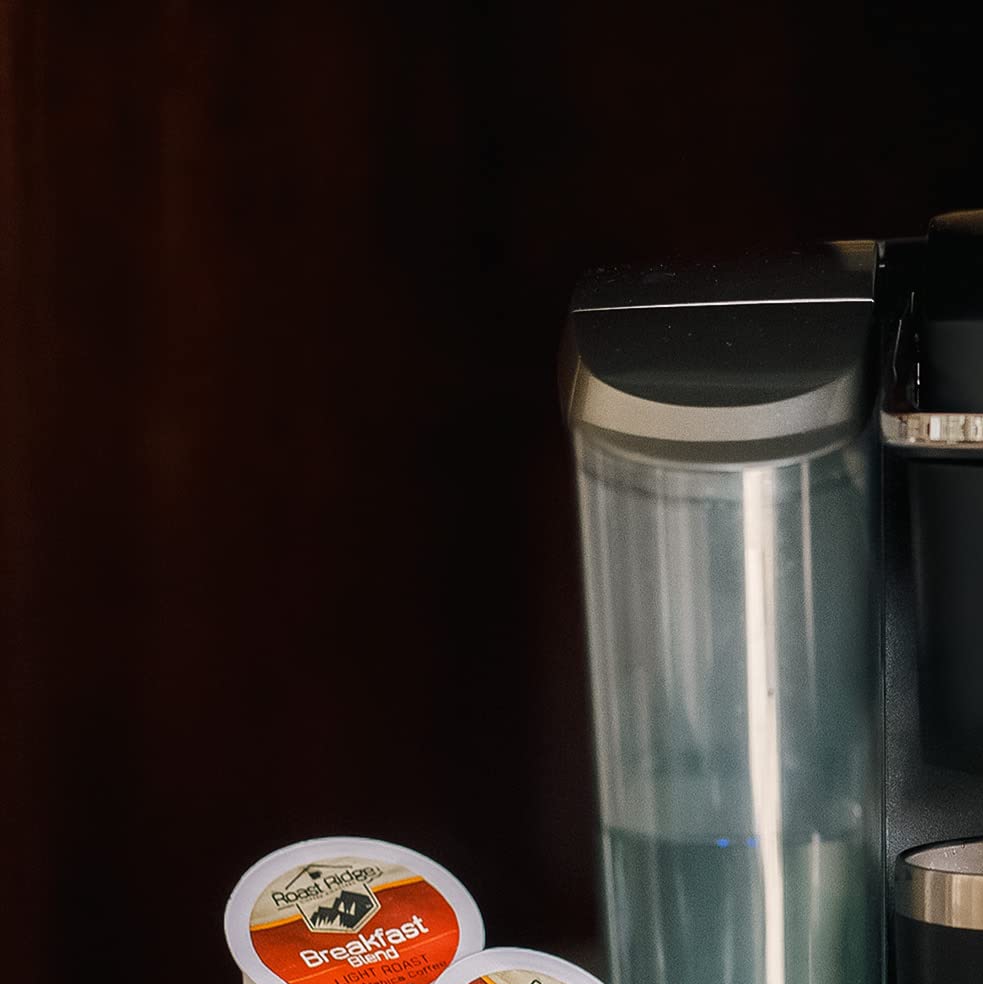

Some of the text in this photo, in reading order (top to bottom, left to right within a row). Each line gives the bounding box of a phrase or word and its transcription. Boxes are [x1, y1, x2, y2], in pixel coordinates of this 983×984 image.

[272, 882, 323, 907] Roast
[325, 866, 377, 890] Ridge
[300, 914, 429, 969] Breakfast
[347, 945, 400, 969] Blend
[381, 953, 430, 976] ROAST
